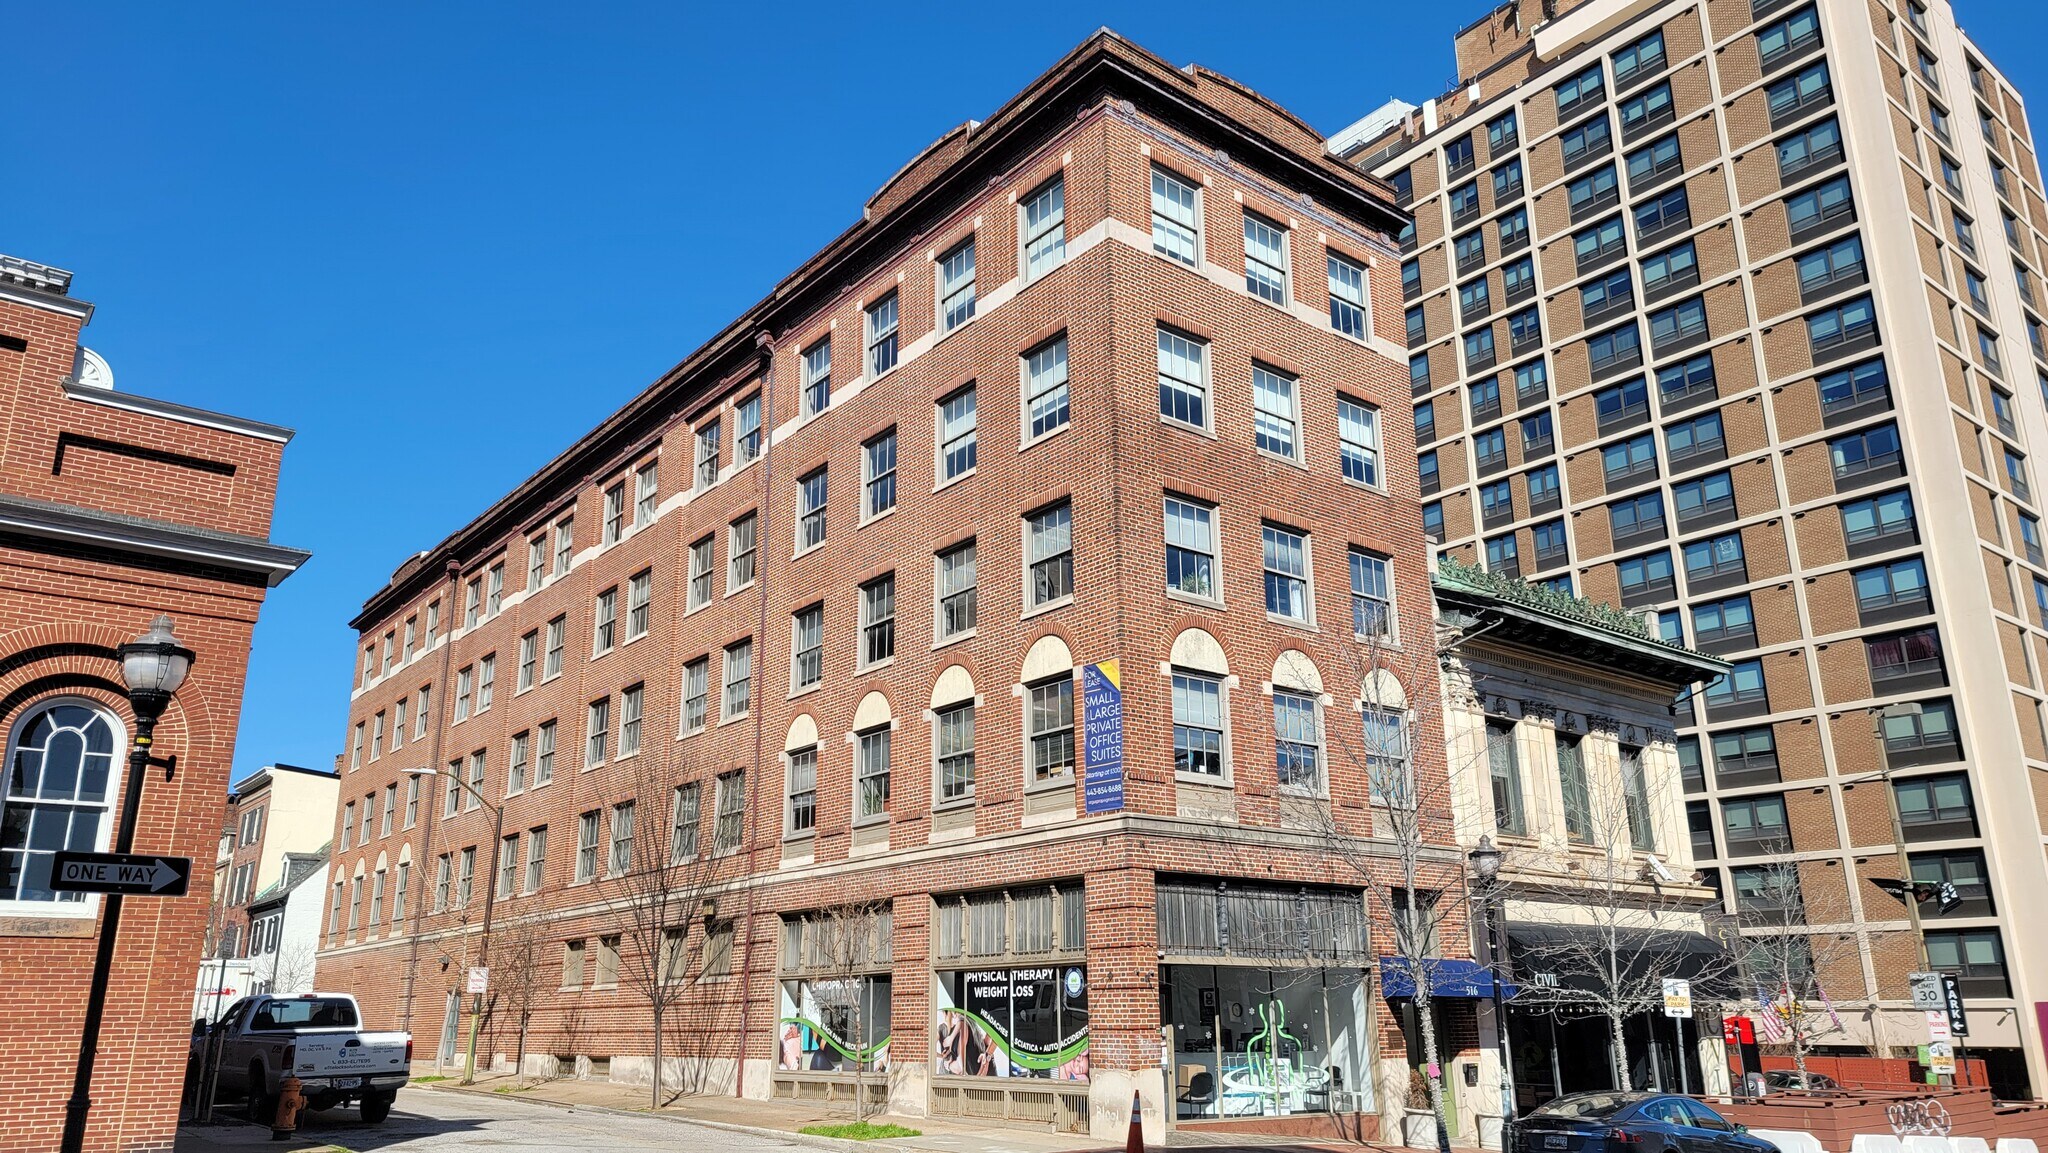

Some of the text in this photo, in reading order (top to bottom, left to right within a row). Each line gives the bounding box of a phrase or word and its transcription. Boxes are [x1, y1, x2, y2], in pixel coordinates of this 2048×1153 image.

[1085, 671, 1096, 680] FOR
[1085, 678, 1100, 688] LEASE
[1086, 691, 1114, 708] SMALL
[1087, 717, 1121, 735] PRIVATE
[1090, 731, 1121, 748] OFFICE
[1091, 745, 1121, 762] SUITES
[66, 864, 158, 882] ONE WAY
[967, 968, 1054, 983] PHYSICAL THERAPY
[1534, 973, 1560, 987] CIVIL
[974, 985, 1034, 998] WEIGHT LOSS
[1466, 985, 1478, 996] 516
[1919, 990, 1938, 1001] 30
[1946, 980, 1962, 1019] PARK
[980, 1008, 1009, 1038] HEADACHES
[822, 1023, 833, 1038] BACK
[832, 1033, 843, 1045] PAIN
[1014, 1025, 1089, 1053] SCIATICA AUTO ACCIDENTS
